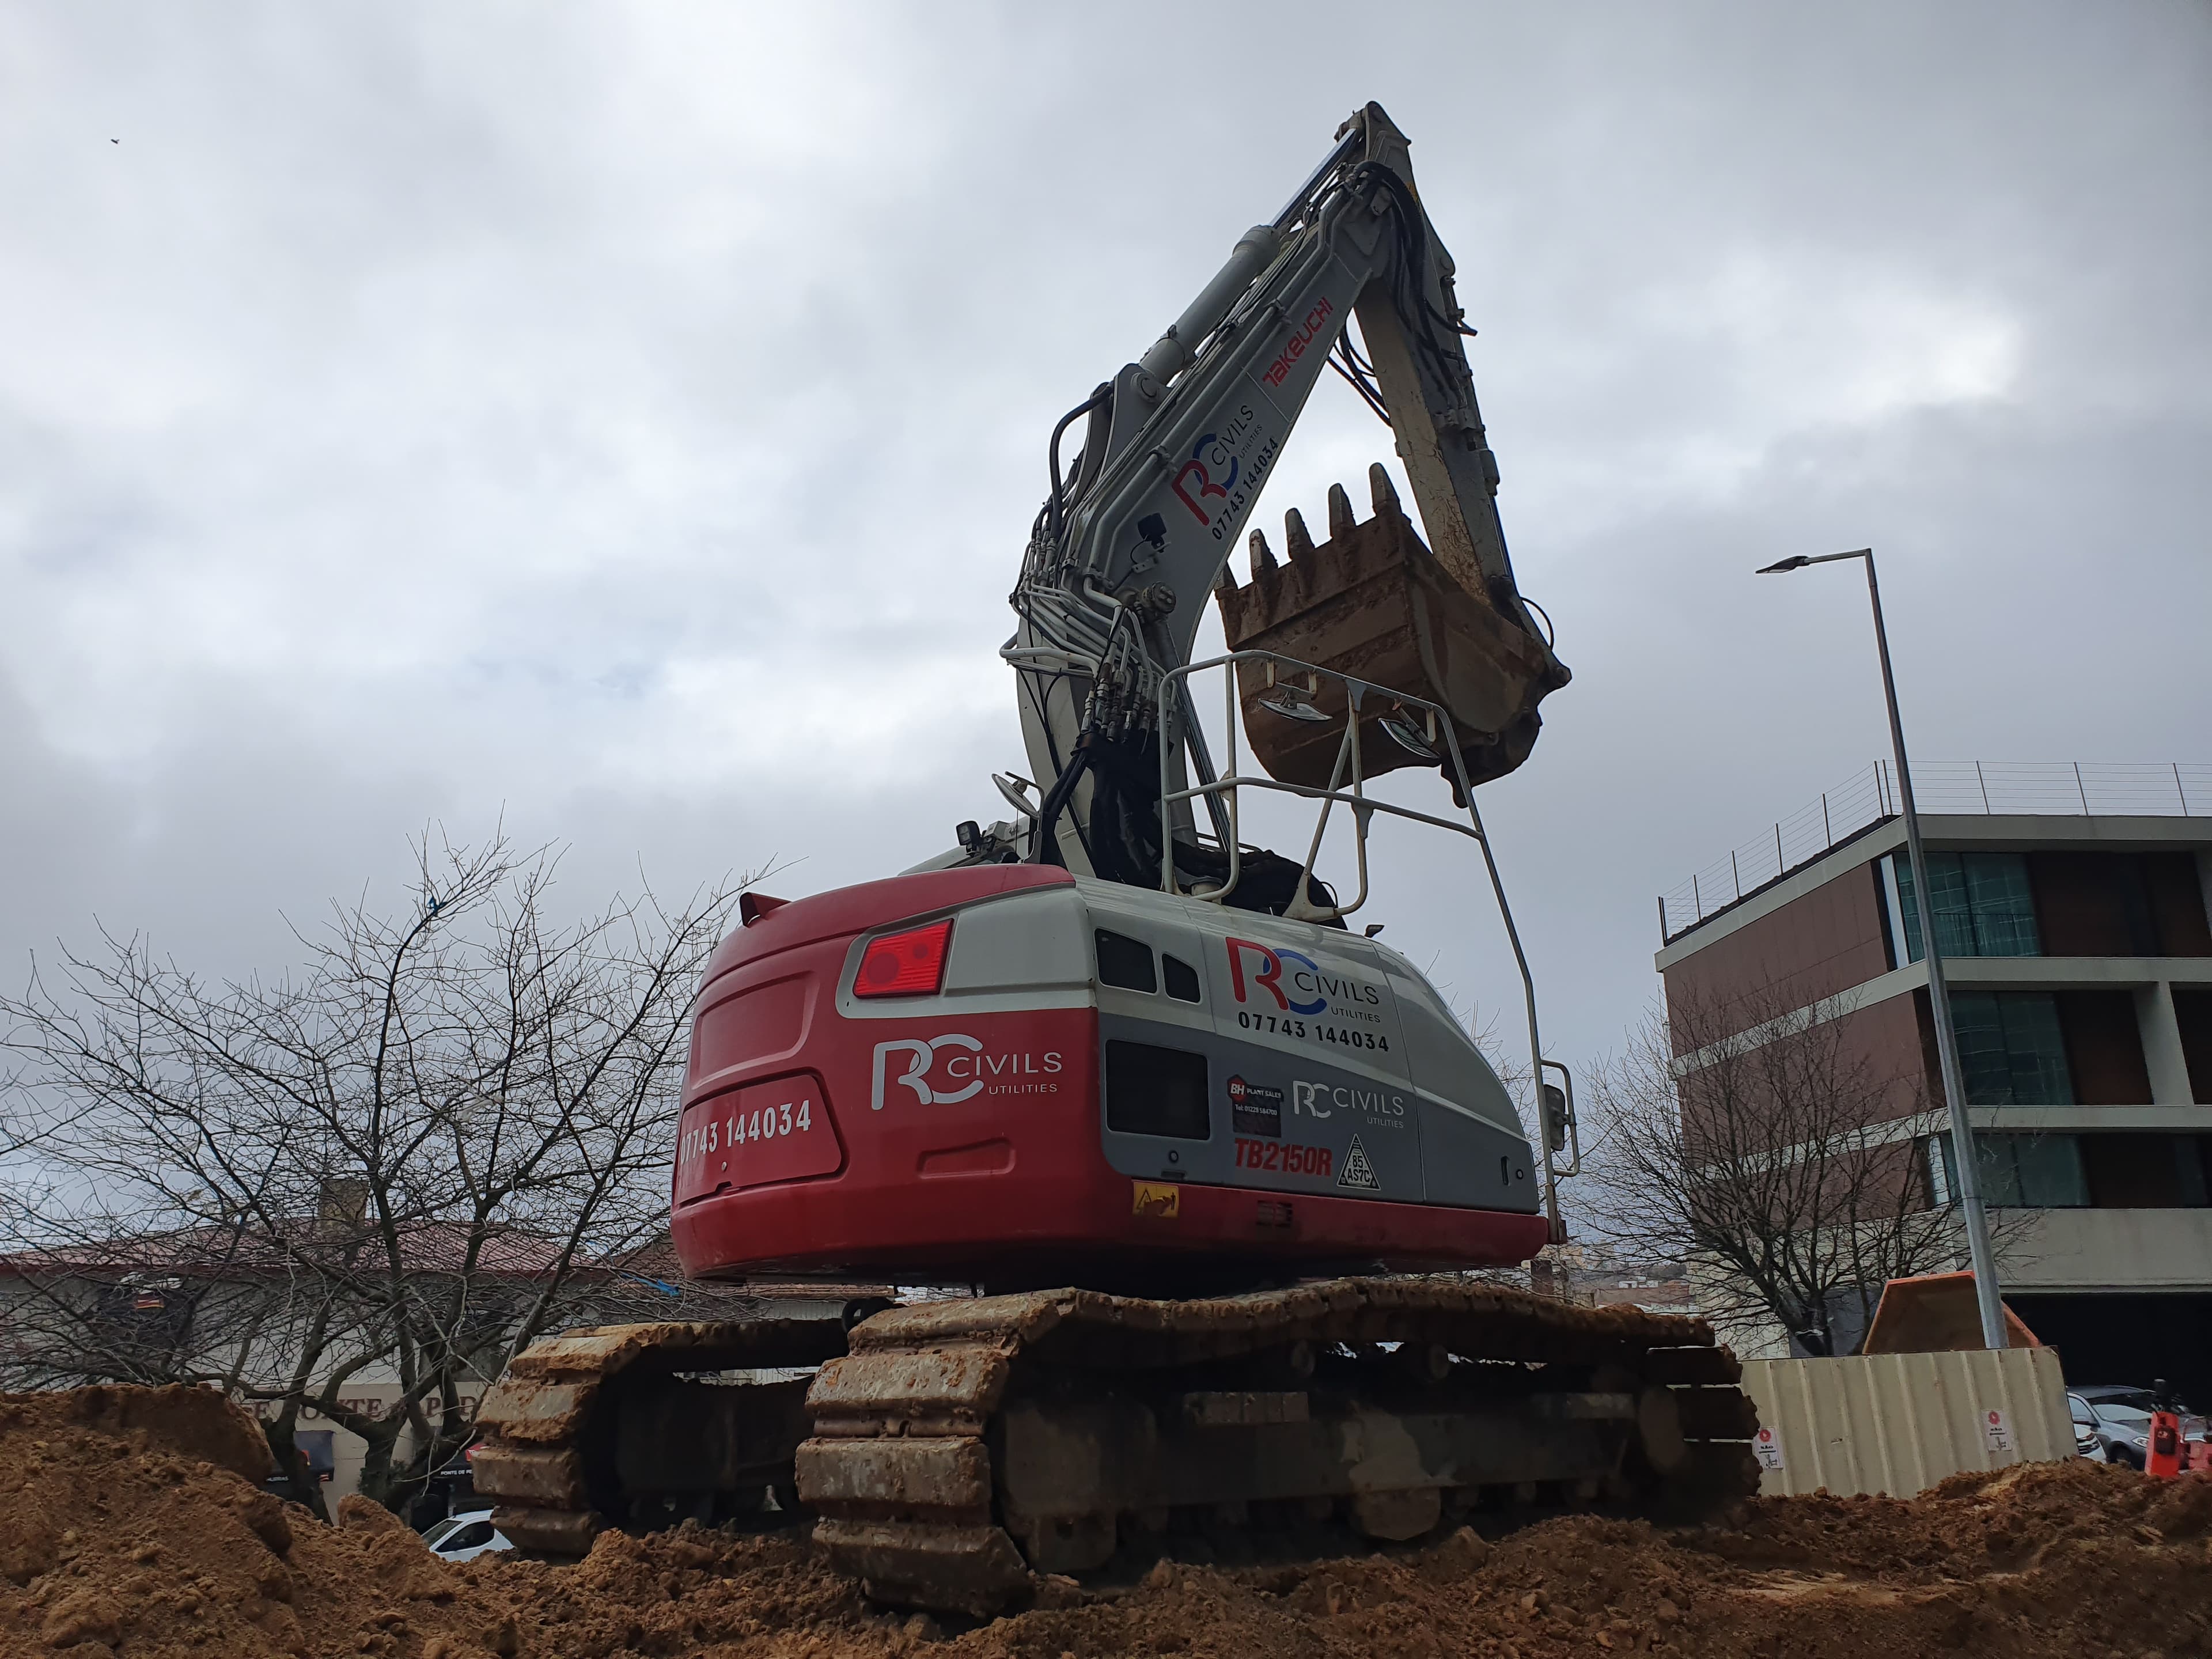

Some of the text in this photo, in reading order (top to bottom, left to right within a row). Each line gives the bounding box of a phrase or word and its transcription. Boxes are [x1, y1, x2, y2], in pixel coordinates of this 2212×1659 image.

[1211, 405, 1254, 466] CIVILS
[1239, 425, 1263, 459] UTILITIES
[1212, 438, 1279, 540] 07743 144034
[1294, 972, 1380, 1005] CIVILS
[1330, 1006, 1381, 1024] UTILITIES
[1237, 1012, 1389, 1052] 07743 144034
[947, 1051, 1063, 1078] CIVILS
[988, 1082, 1058, 1095] UTILITIES
[1230, 1083, 1245, 1096] BH
[1264, 1090, 1282, 1099] SALES
[1333, 1088, 1404, 1116] CIVILS
[680, 1100, 811, 1165] 07743 144034
[1366, 1116, 1404, 1128] UTILITIES
[1234, 1138, 1333, 1176] TB2150R
[1352, 1155, 1363, 1168] 85
[1347, 1168, 1370, 1183] AS7C
